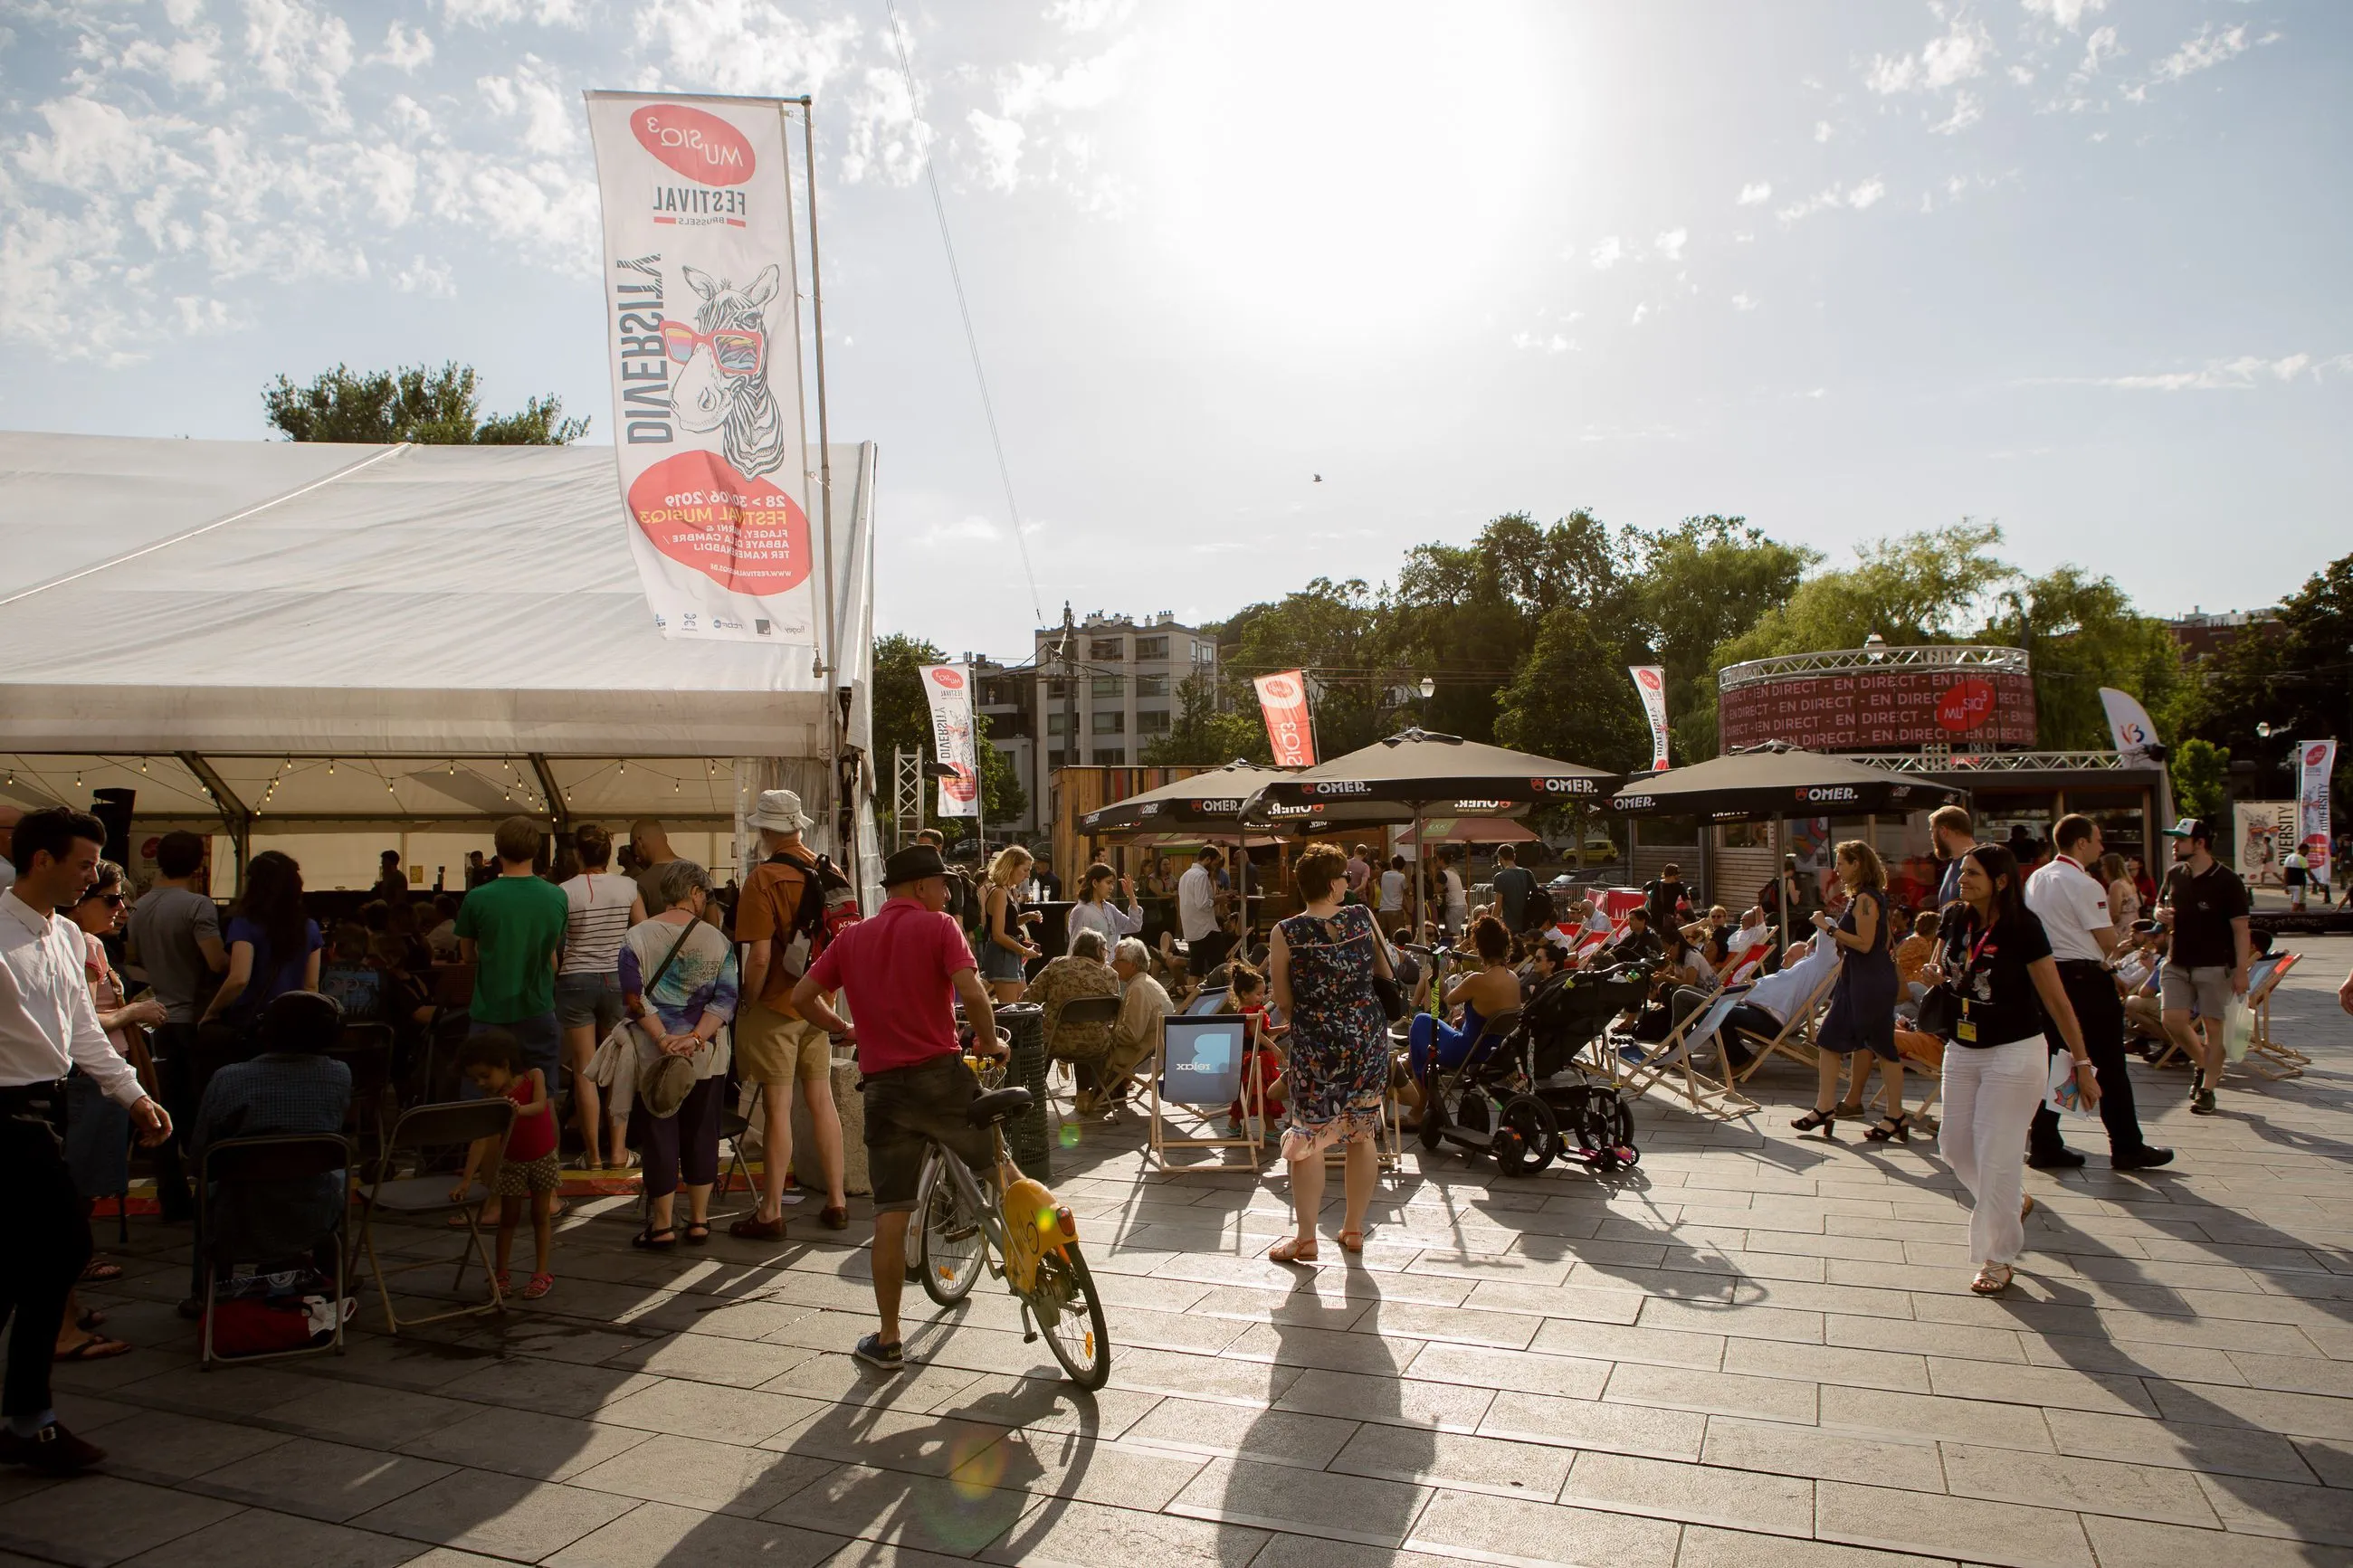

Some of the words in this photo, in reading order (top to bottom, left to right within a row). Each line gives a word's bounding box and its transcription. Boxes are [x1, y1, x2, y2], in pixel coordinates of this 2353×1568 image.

[1772, 680, 1818, 697] DIRECT
[1834, 679, 1853, 691] EN
[1860, 675, 1917, 689] DIRECT
[1932, 675, 1950, 687] EN
[1779, 701, 1796, 713] EN
[1801, 696, 1853, 711] DIRECT
[1871, 694, 1891, 706] EN
[1897, 692, 1946, 705] DIREC
[1774, 716, 1822, 731] DIRECT
[1835, 714, 1855, 726] EN
[1862, 710, 1919, 725] DIRECT
[1803, 731, 1856, 746] DIRECT
[1872, 729, 1893, 742] EN
[1317, 782, 1371, 794] OMER.
[1545, 779, 1598, 794] OMER.
[1808, 787, 1859, 801] OMER.
[1614, 796, 1656, 811] OMER.
